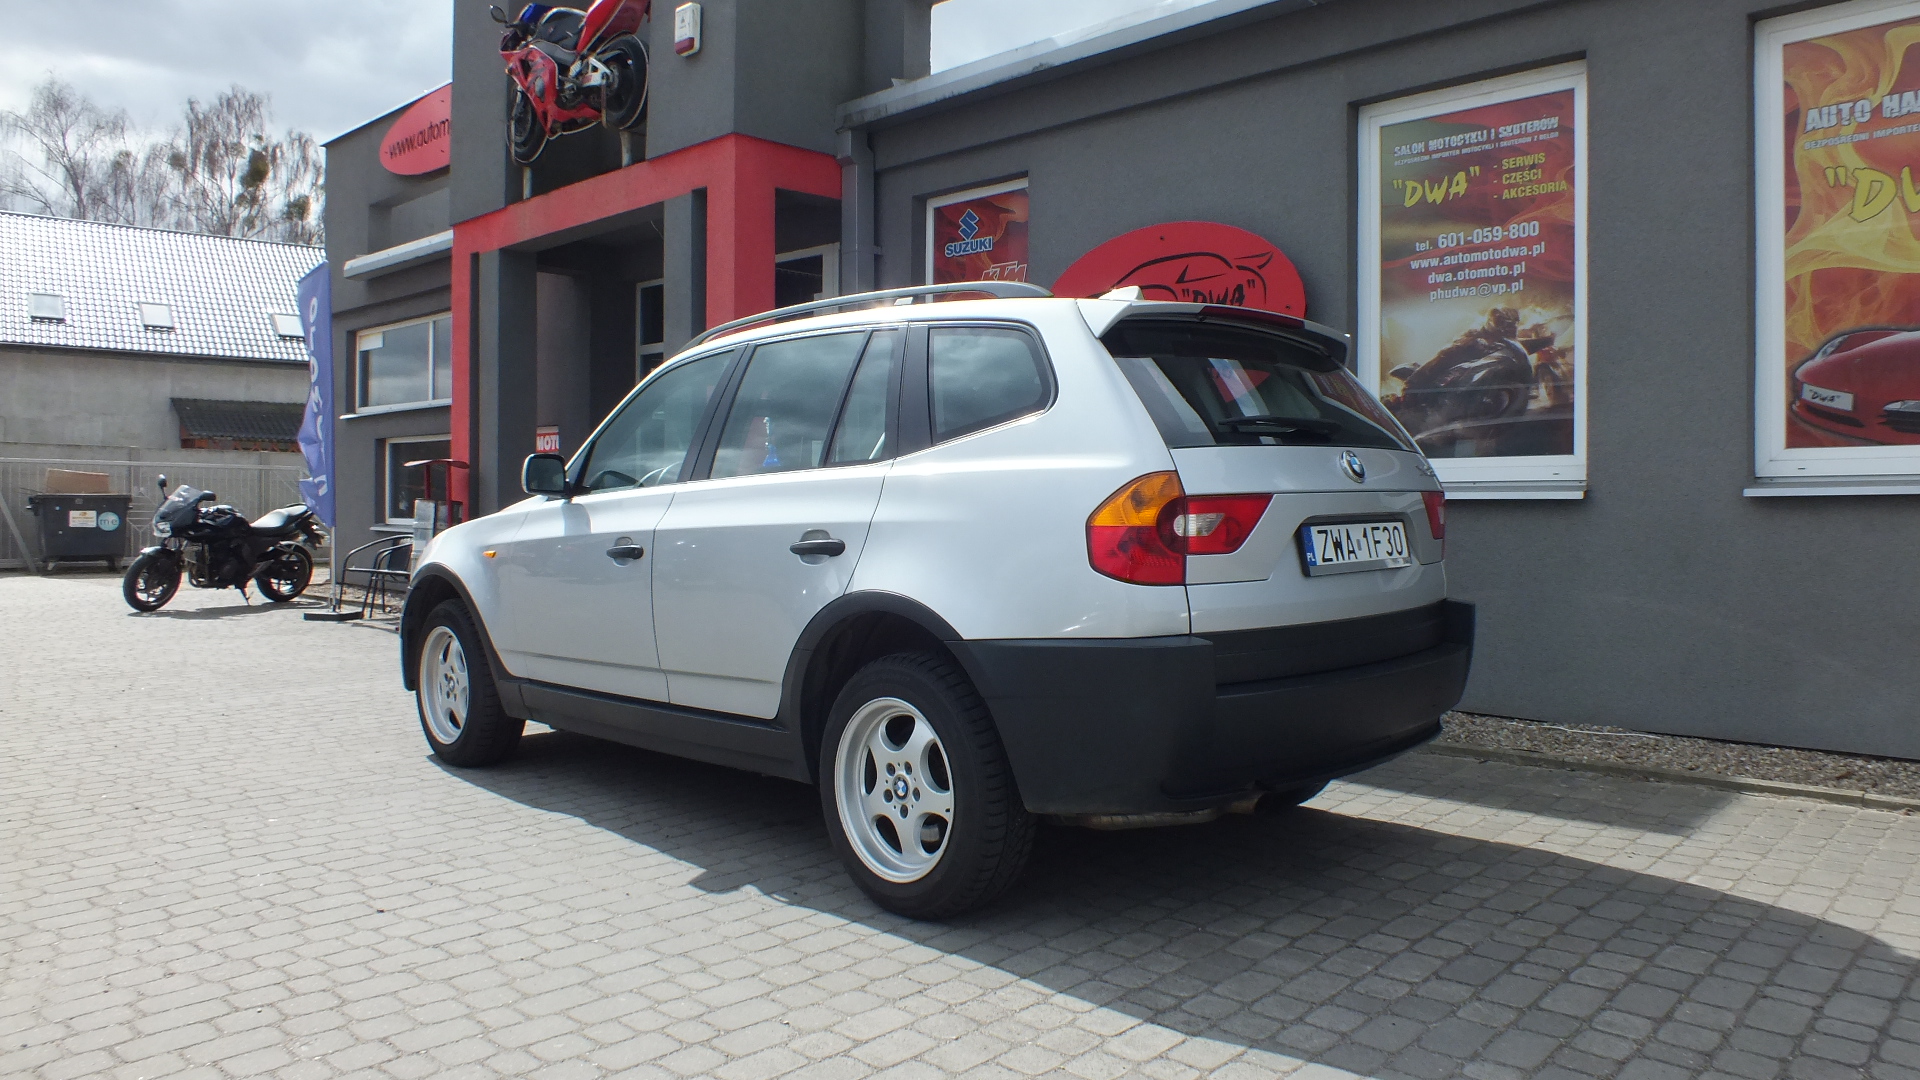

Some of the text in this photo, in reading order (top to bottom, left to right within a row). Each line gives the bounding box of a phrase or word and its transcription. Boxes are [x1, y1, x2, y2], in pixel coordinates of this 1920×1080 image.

[1804, 89, 1920, 134] AUTO HA
[1394, 141, 1425, 157] SALON
[1428, 129, 1487, 151] MOTOCYKLI
[1498, 114, 1559, 139] SKUTERÓW
[1873, 123, 1920, 139] IMPORTE
[1502, 152, 1546, 170] SERWIS
[1502, 168, 1541, 185] CZĘŚCI
[1502, 180, 1567, 200] AKCESORIA
[945, 236, 993, 257] SUZUKI
[1415, 220, 1540, 252] tel. 601-059-800
[1410, 241, 1545, 270] www.automotodwa.pl
[1428, 261, 1526, 284] dwa.otomoto.pl
[1430, 279, 1524, 302] phudwa@vp.pl
[1317, 525, 1404, 562] ZWA 1F30
[1306, 552, 1316, 562] PL
